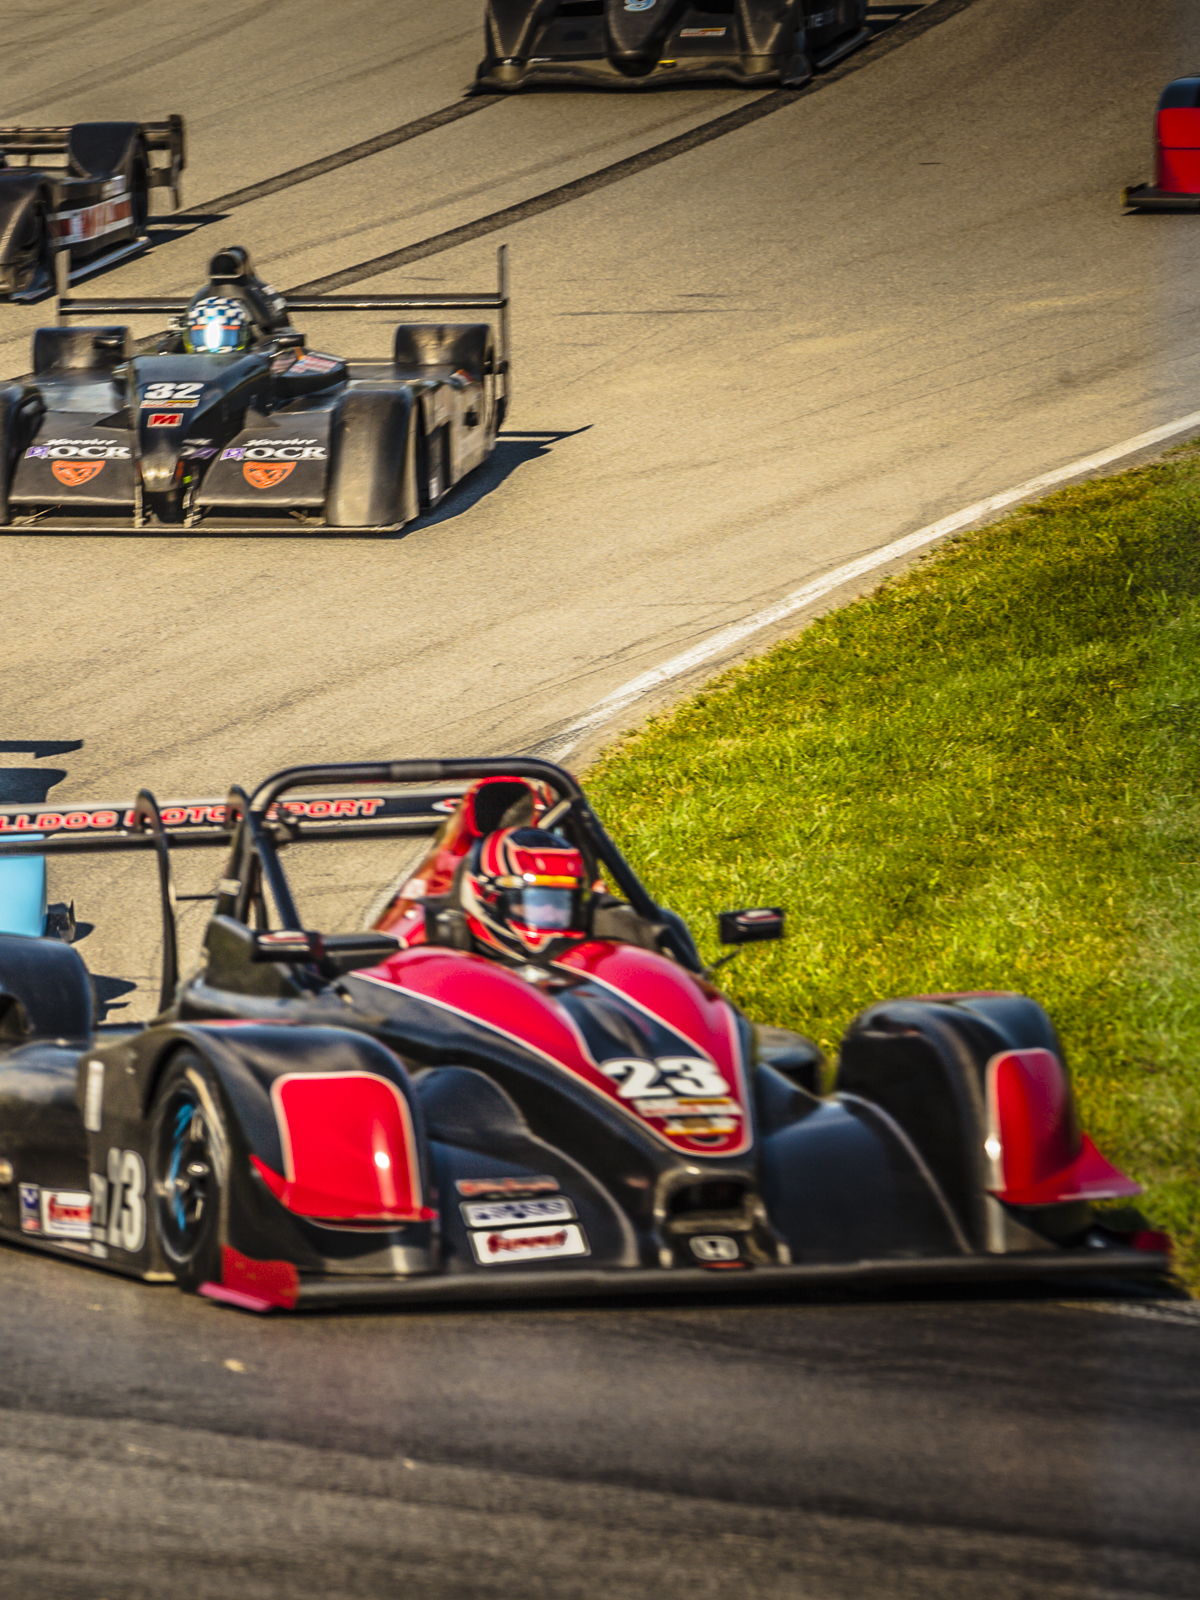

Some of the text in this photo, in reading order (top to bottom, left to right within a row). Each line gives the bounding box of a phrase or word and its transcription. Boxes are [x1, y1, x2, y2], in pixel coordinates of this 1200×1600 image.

[144, 382, 204, 400] 32
[48, 445, 132, 459] OCR
[244, 447, 328, 460] OCR
[602, 1056, 731, 1099] 23
